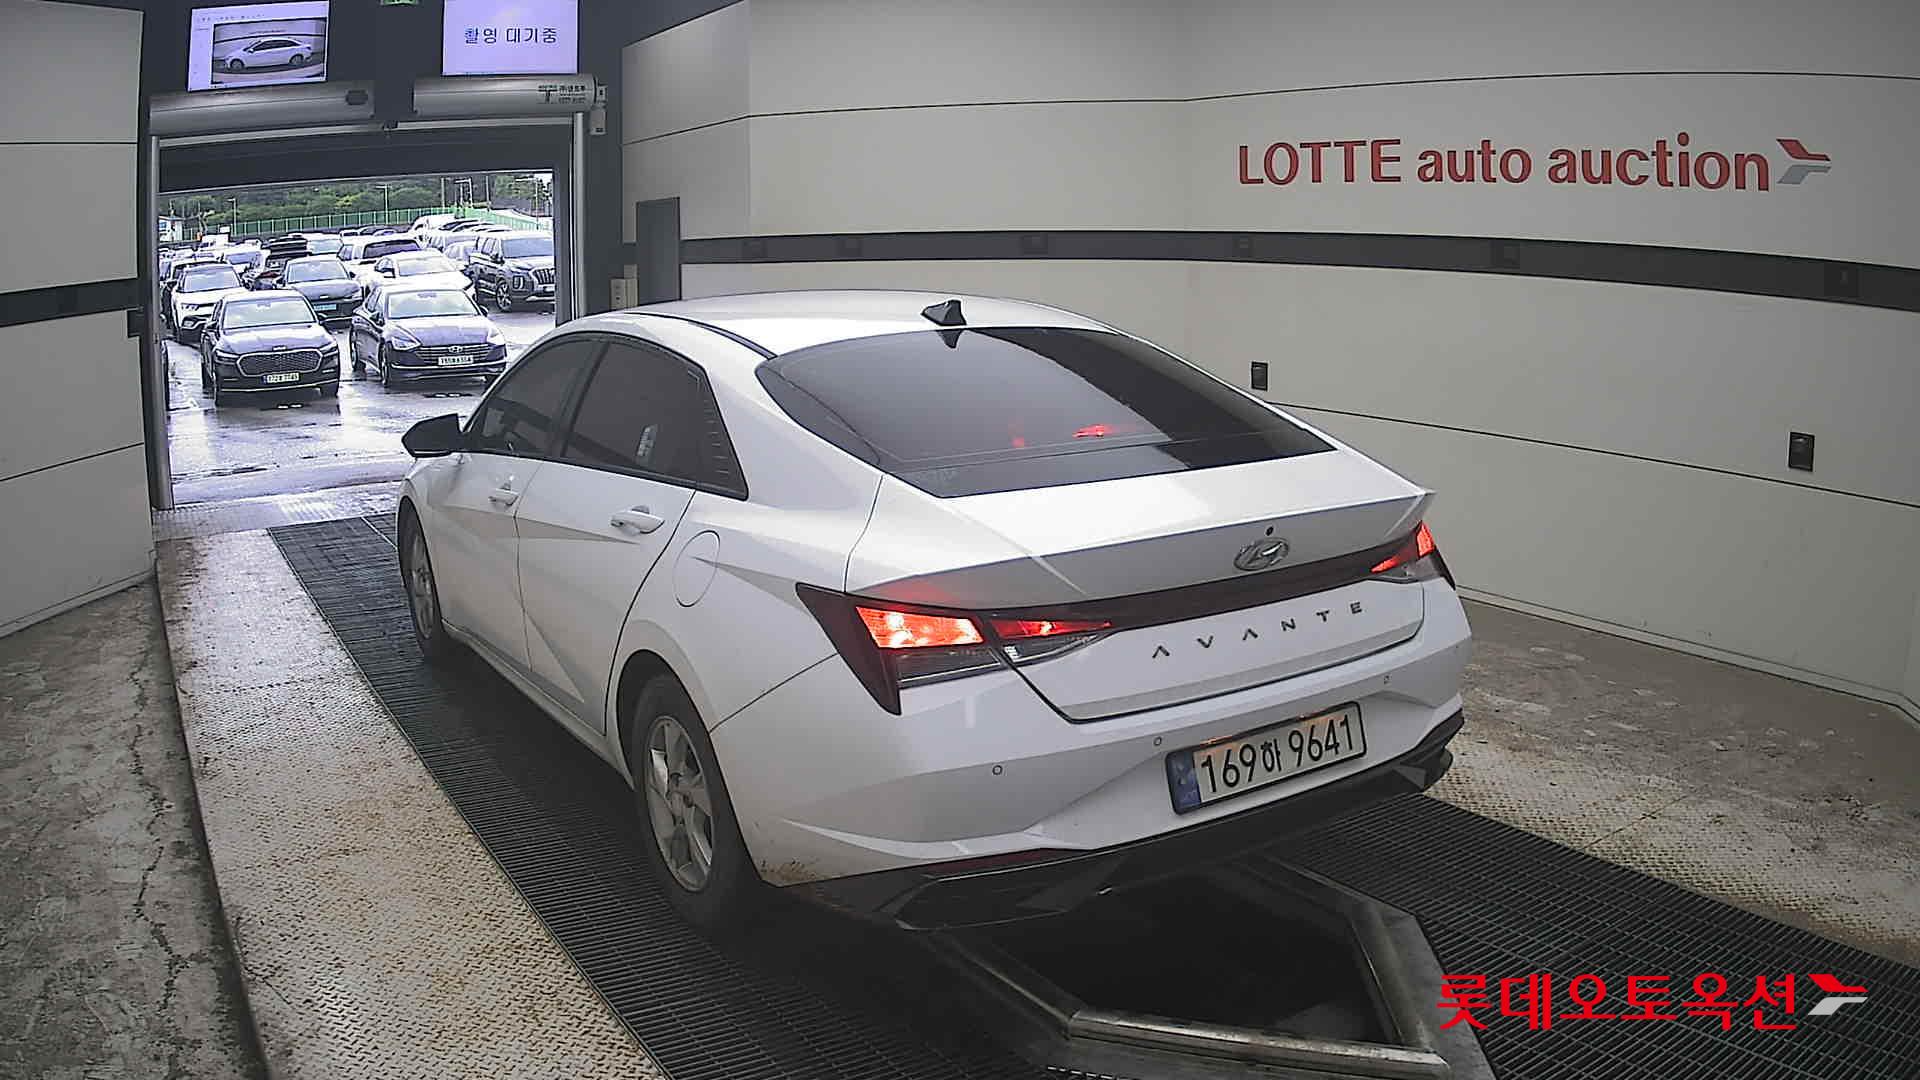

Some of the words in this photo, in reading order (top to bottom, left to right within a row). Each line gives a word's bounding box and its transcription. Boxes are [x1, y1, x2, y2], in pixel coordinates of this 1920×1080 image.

[464, 27, 497, 44] 촬영
[505, 27, 557, 44] 대기중
[1239, 139, 1401, 186] LOTTE
[1417, 139, 1533, 184] auto
[1548, 132, 1769, 191] auction
[1152, 601, 1363, 660] AVANTE
[1201, 739, 1281, 793] 169하
[1288, 714, 1353, 768] 9641
